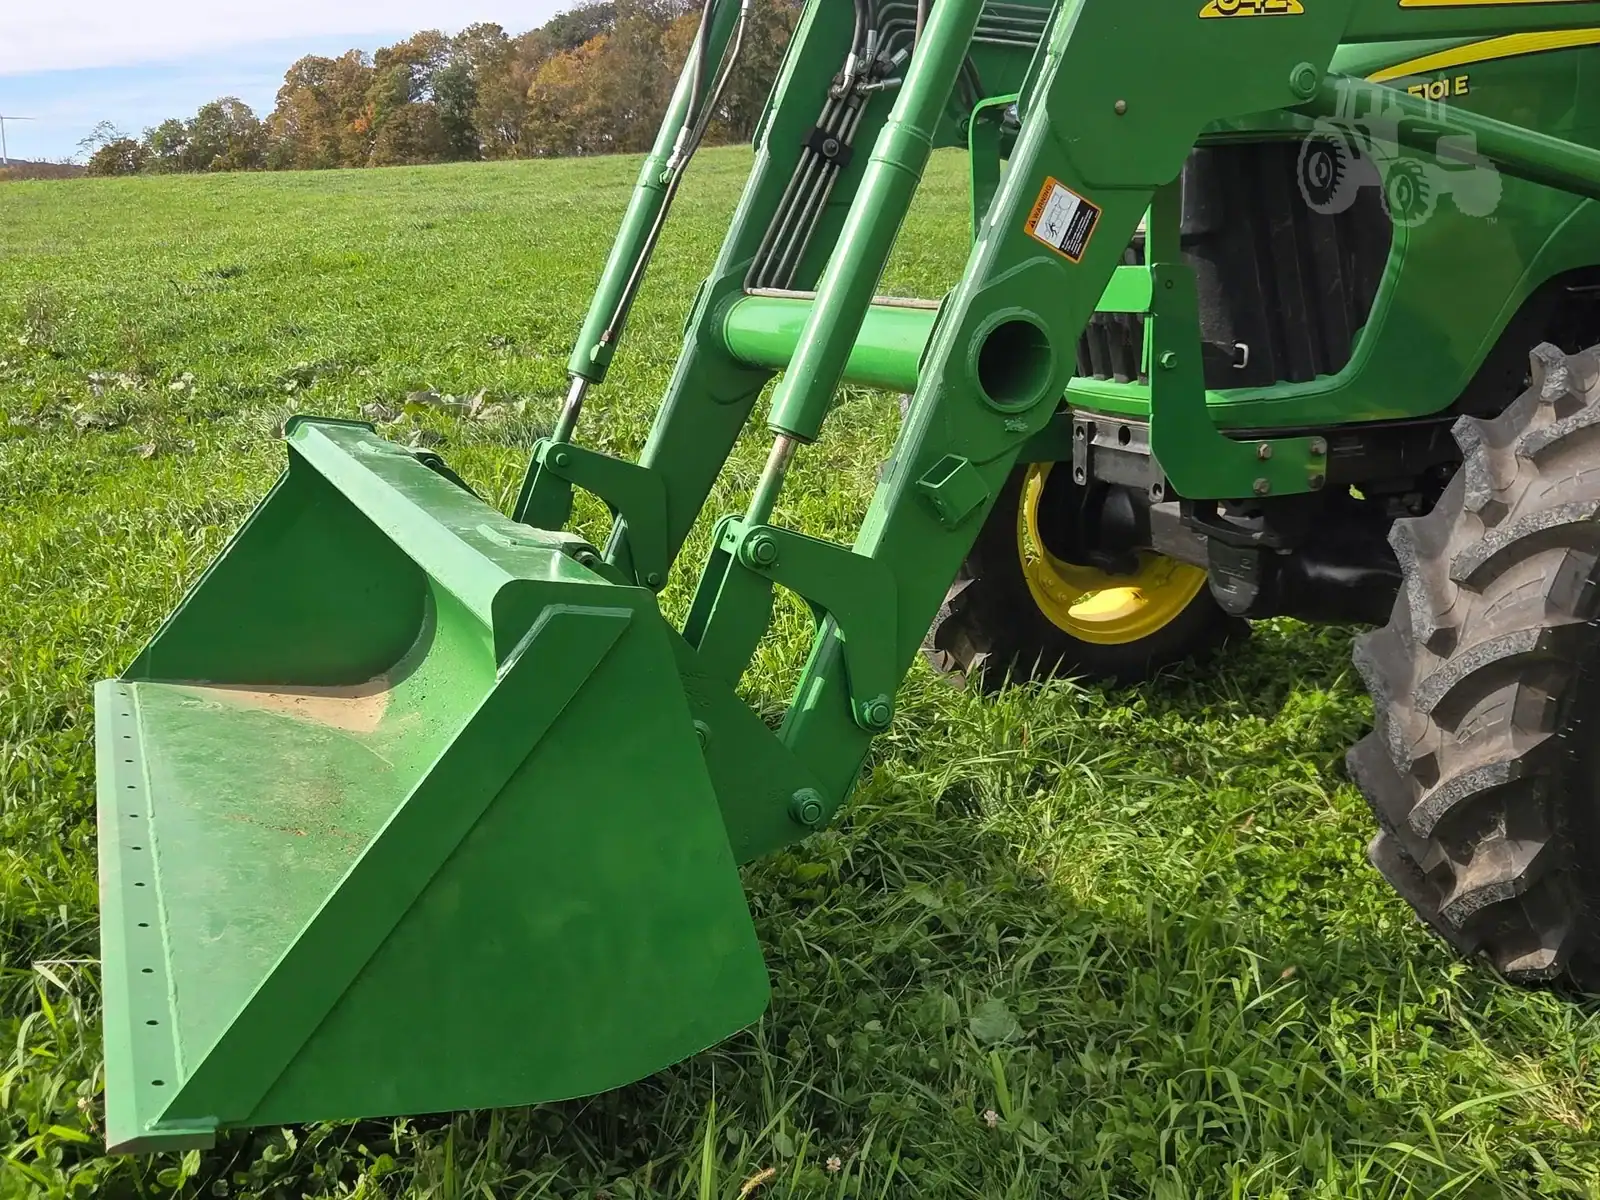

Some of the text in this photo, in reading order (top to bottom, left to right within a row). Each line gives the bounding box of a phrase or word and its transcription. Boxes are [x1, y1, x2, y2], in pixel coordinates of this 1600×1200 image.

[1407, 75, 1469, 100] 5101 E
[1032, 184, 1052, 219] WARNING
